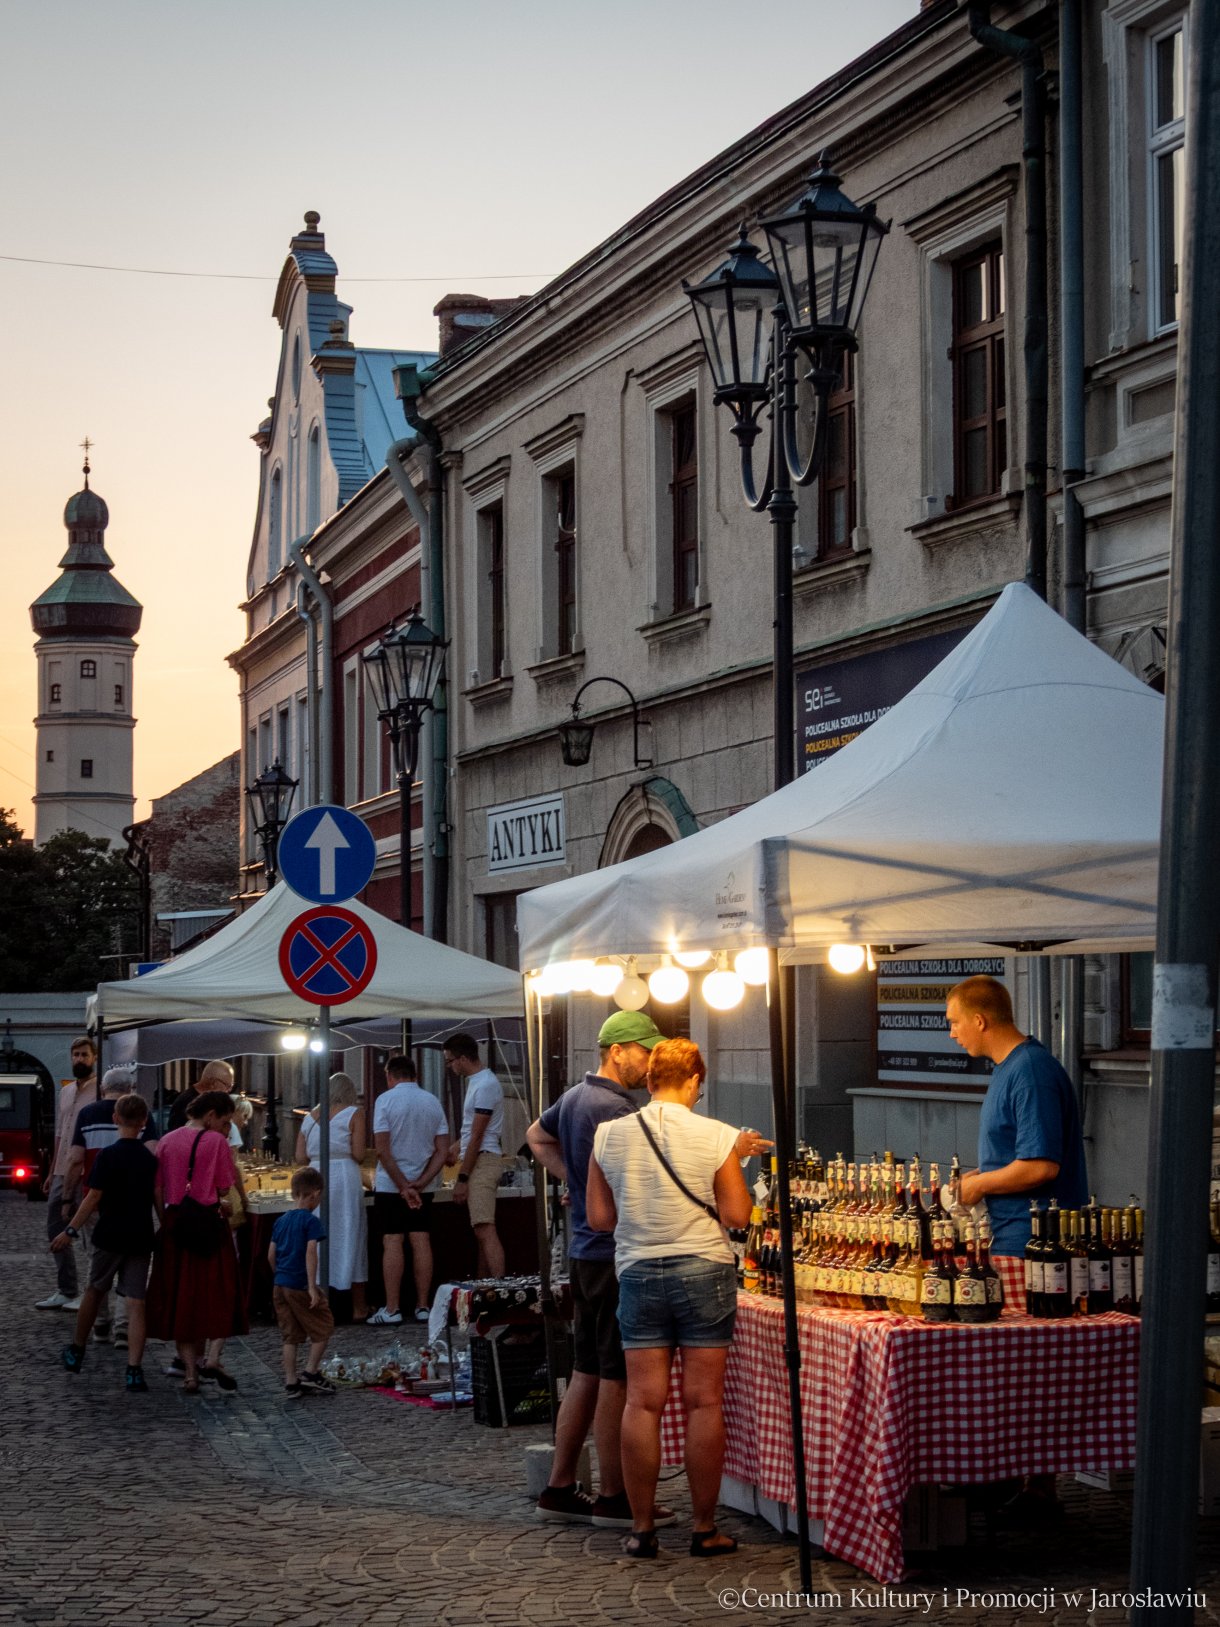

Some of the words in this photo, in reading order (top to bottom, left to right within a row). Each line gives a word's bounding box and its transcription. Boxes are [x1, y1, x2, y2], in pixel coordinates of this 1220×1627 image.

[805, 719, 840, 737] POLICEALNA
[840, 714, 863, 728] SZKOŁA
[864, 710, 877, 723] DLA
[805, 737, 840, 753] POLICEALNA
[491, 809, 562, 862] ANTYKI
[880, 961, 919, 974] POLICEALNA
[920, 960, 946, 974] SZKOŁA
[948, 960, 962, 973] DLA
[880, 987, 918, 1001] POLICEALNA
[921, 987, 947, 1000] SZKOŁA
[880, 1015, 919, 1028] POLICEALNA
[921, 1015, 947, 1028] SZKOŁA
